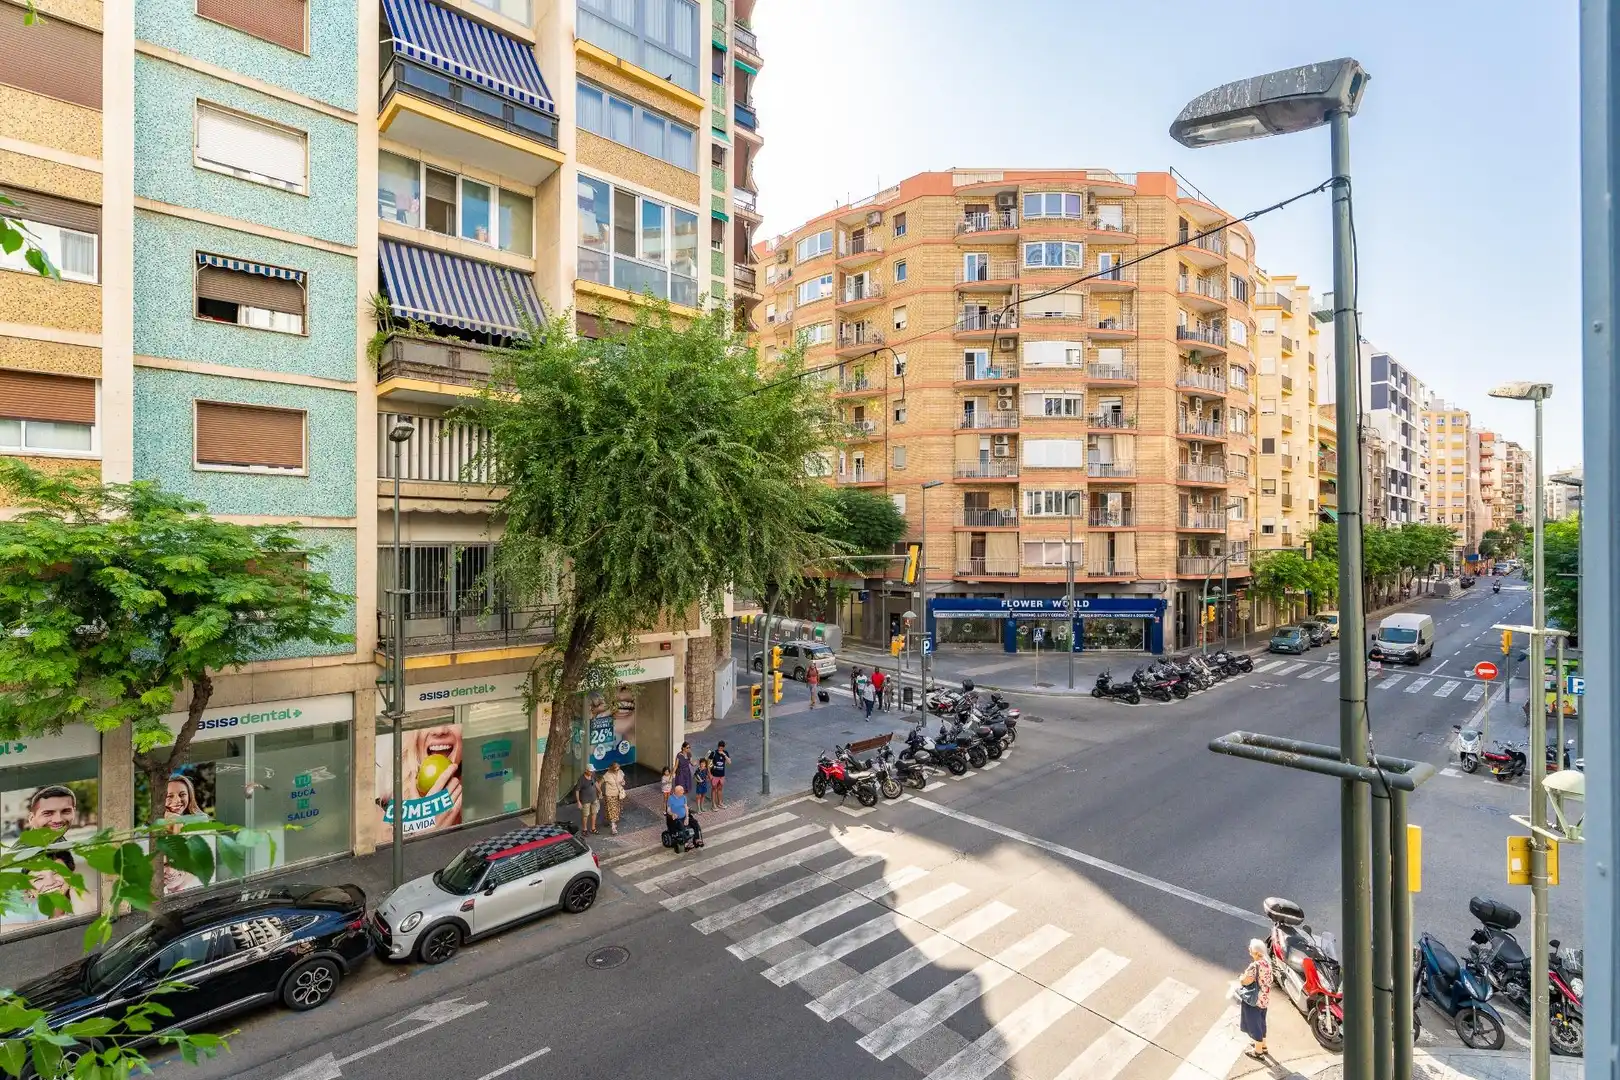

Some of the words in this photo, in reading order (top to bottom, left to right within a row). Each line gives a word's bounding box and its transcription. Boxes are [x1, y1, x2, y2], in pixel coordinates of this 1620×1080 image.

[1001, 600, 1043, 608] FLOWER
[591, 728, 613, 744] 26%
[291, 788, 316, 799] BOCA
[287, 808, 320, 821] SALUD
[404, 824, 414, 832] LA
[416, 819, 436, 829] VIDA
